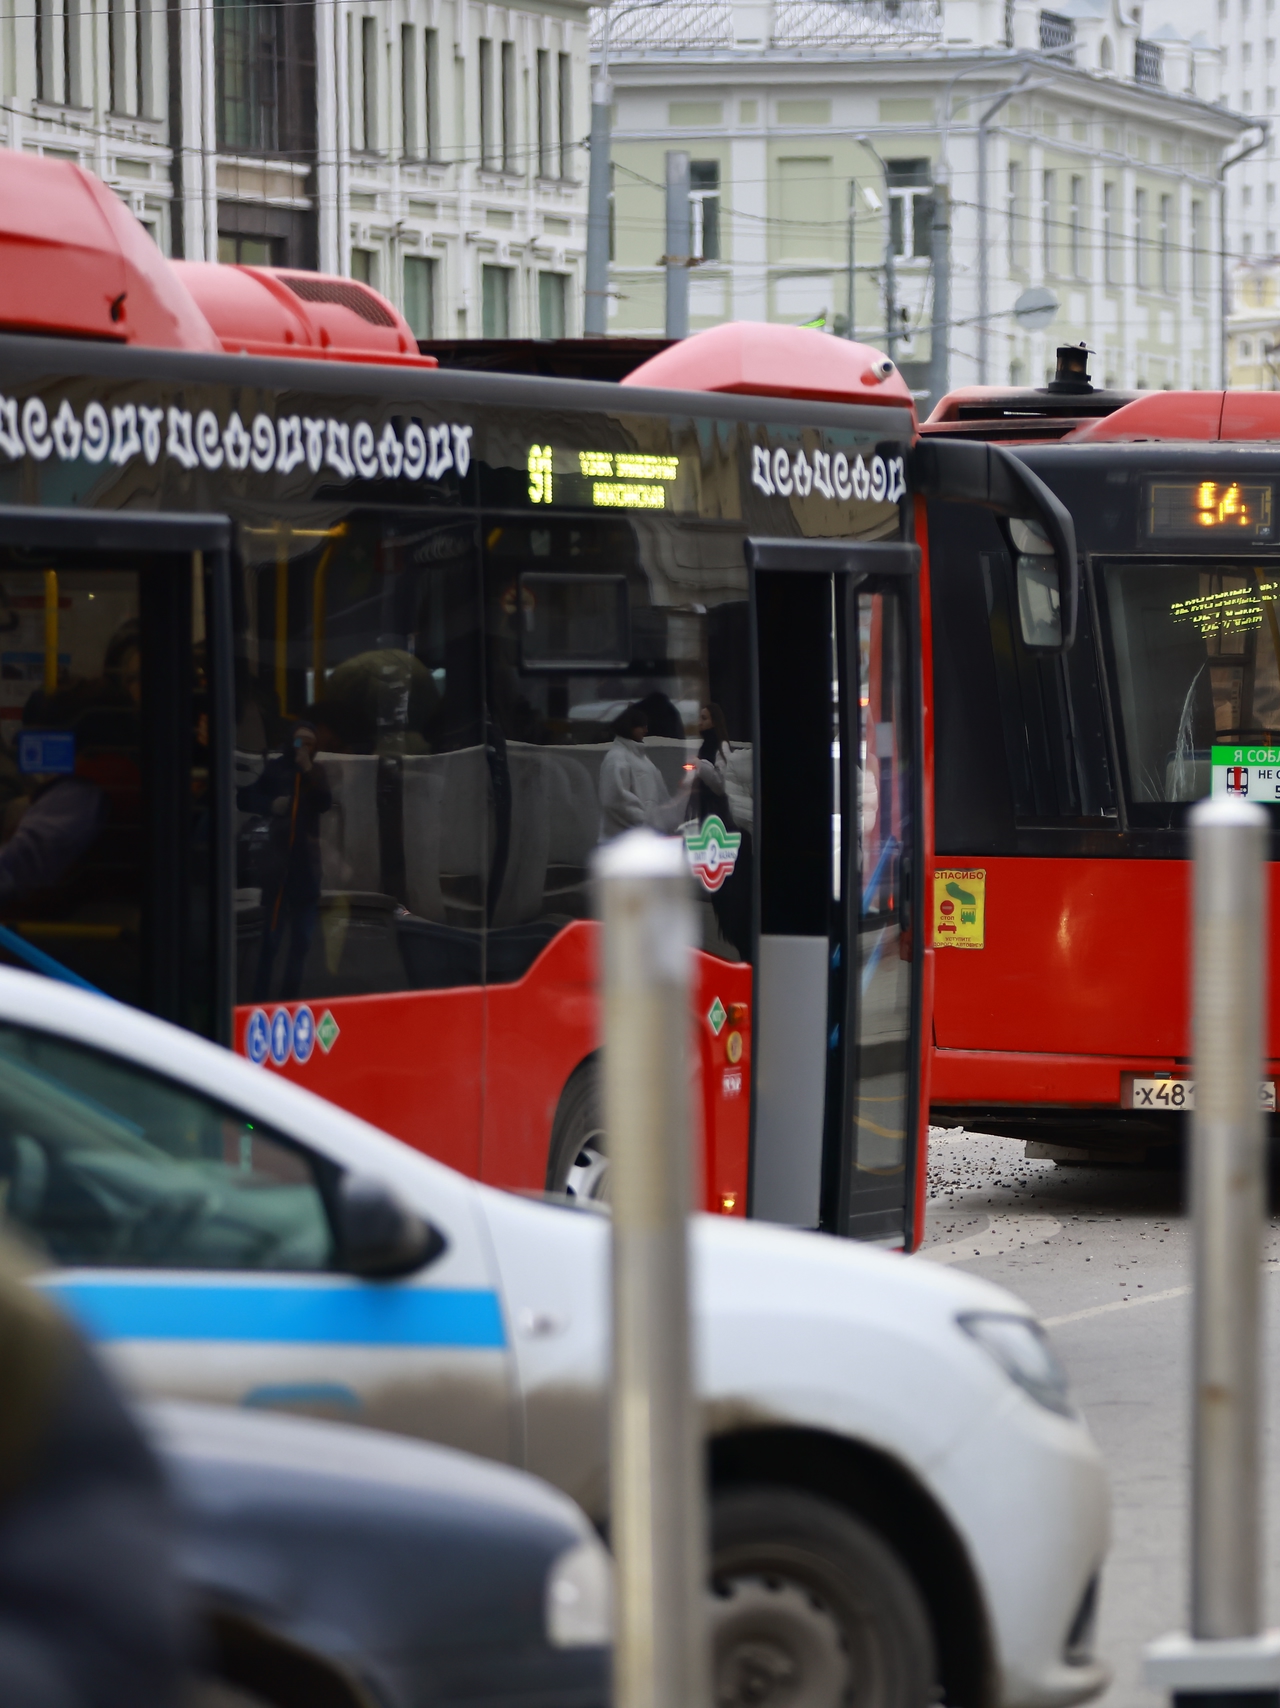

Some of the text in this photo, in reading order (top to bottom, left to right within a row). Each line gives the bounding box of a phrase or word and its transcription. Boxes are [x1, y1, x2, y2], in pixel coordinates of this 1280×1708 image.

[1234, 751, 1243, 763] Я
[1258, 770, 1273, 780] НЕ
[710, 844, 718, 865] 2
[934, 871, 984, 880] СПАСИБО
